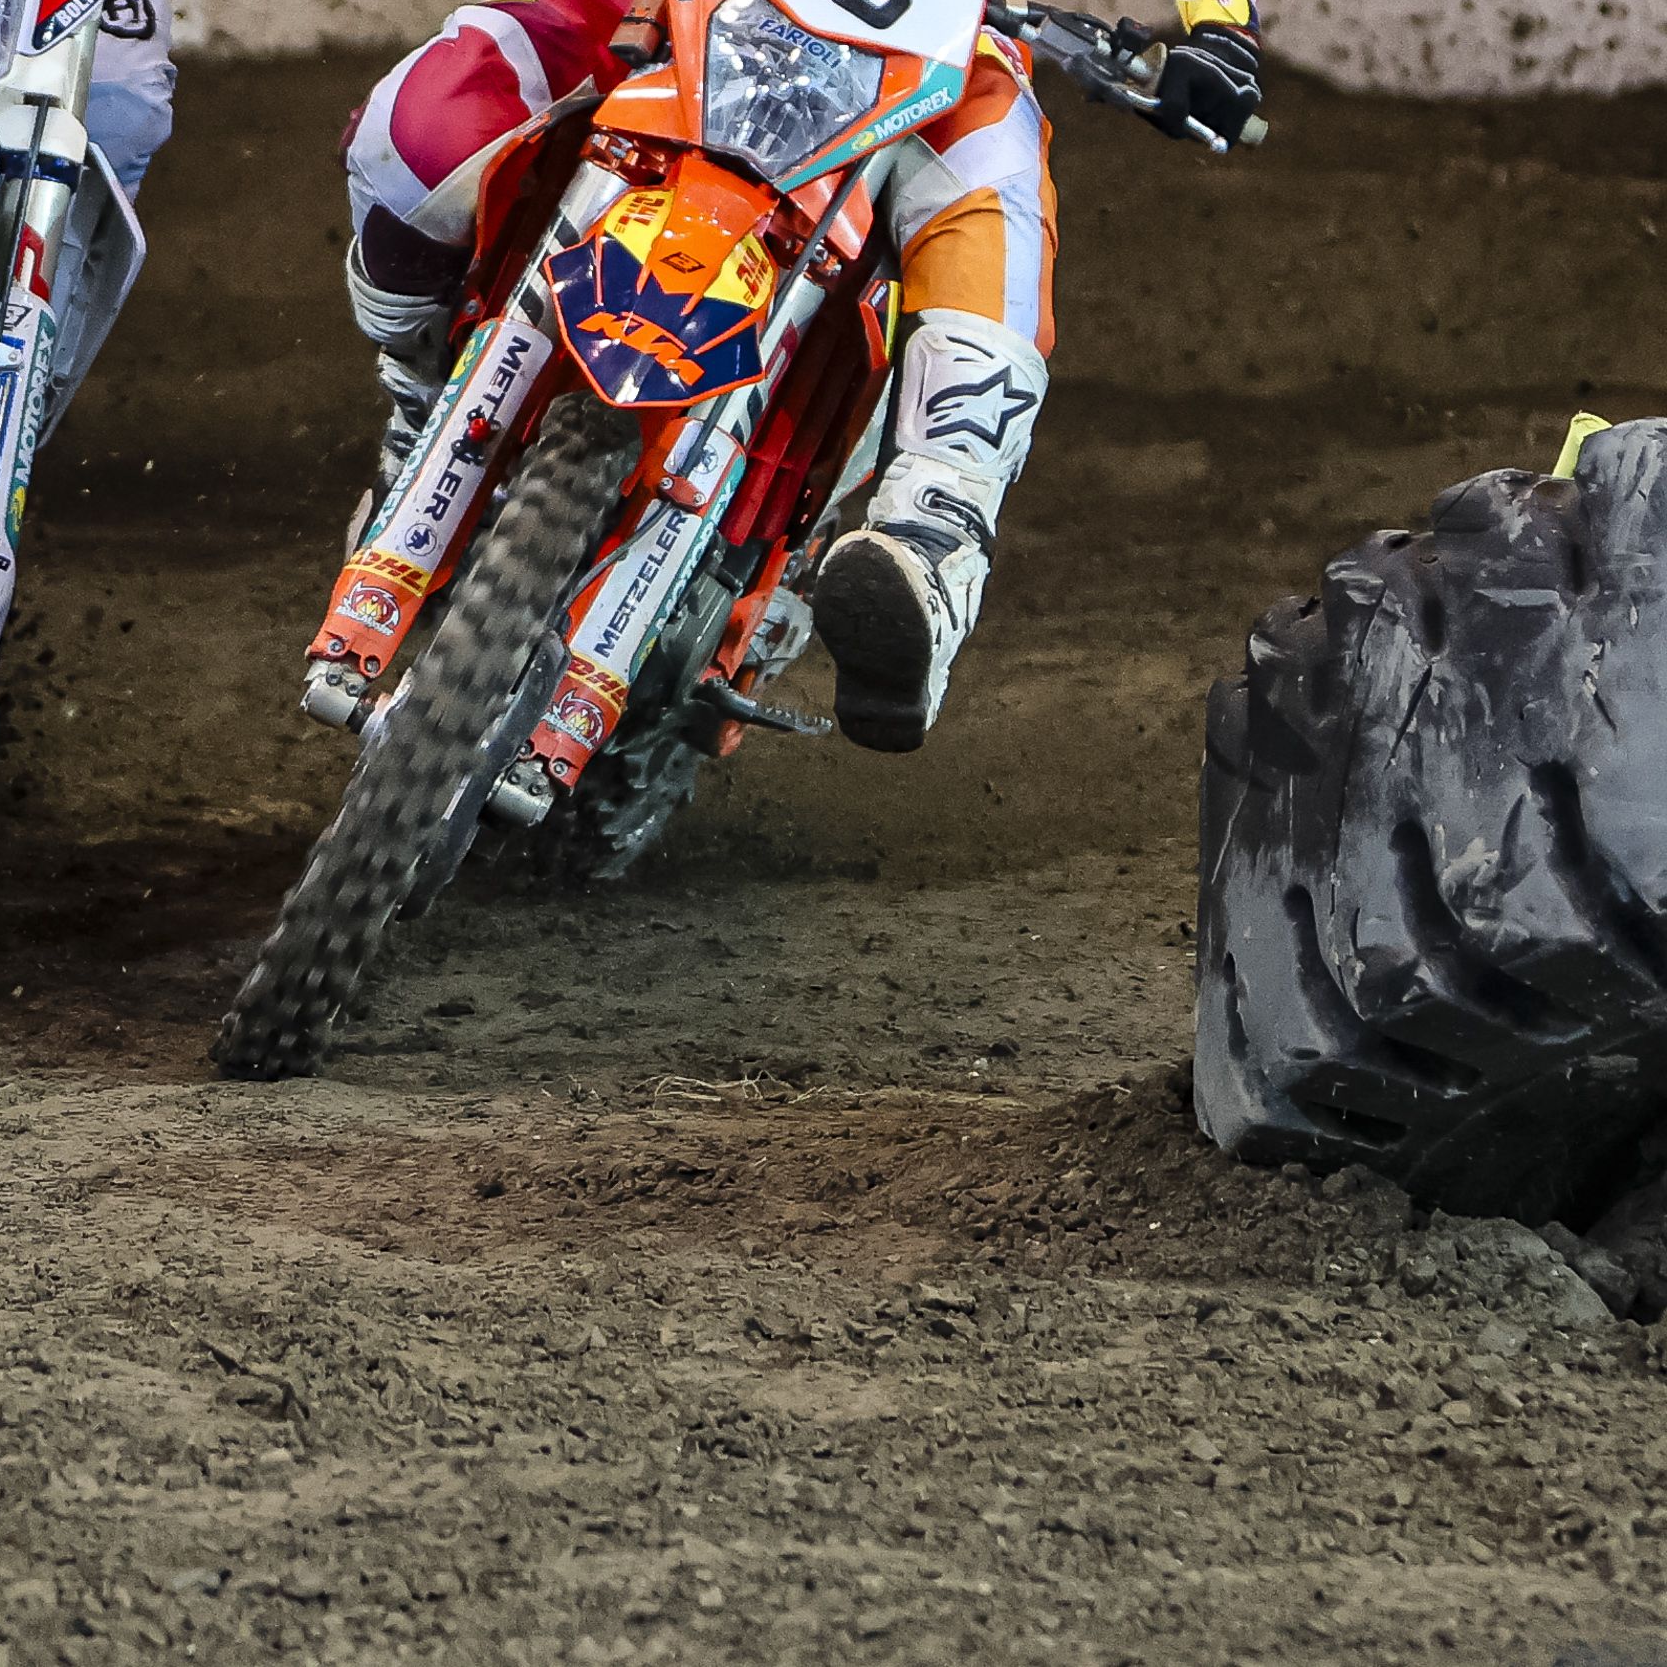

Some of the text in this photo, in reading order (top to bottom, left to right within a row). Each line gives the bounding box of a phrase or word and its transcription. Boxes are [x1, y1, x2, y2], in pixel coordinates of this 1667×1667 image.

[757, 18, 844, 71] FARIOLI
[873, 85, 954, 141] MOTOREX
[575, 310, 707, 387] KTM
[13, 325, 55, 485] MOTOREX
[422, 335, 532, 524] METLER
[360, 549, 426, 591] DHL
[593, 511, 690, 661] METZELER
